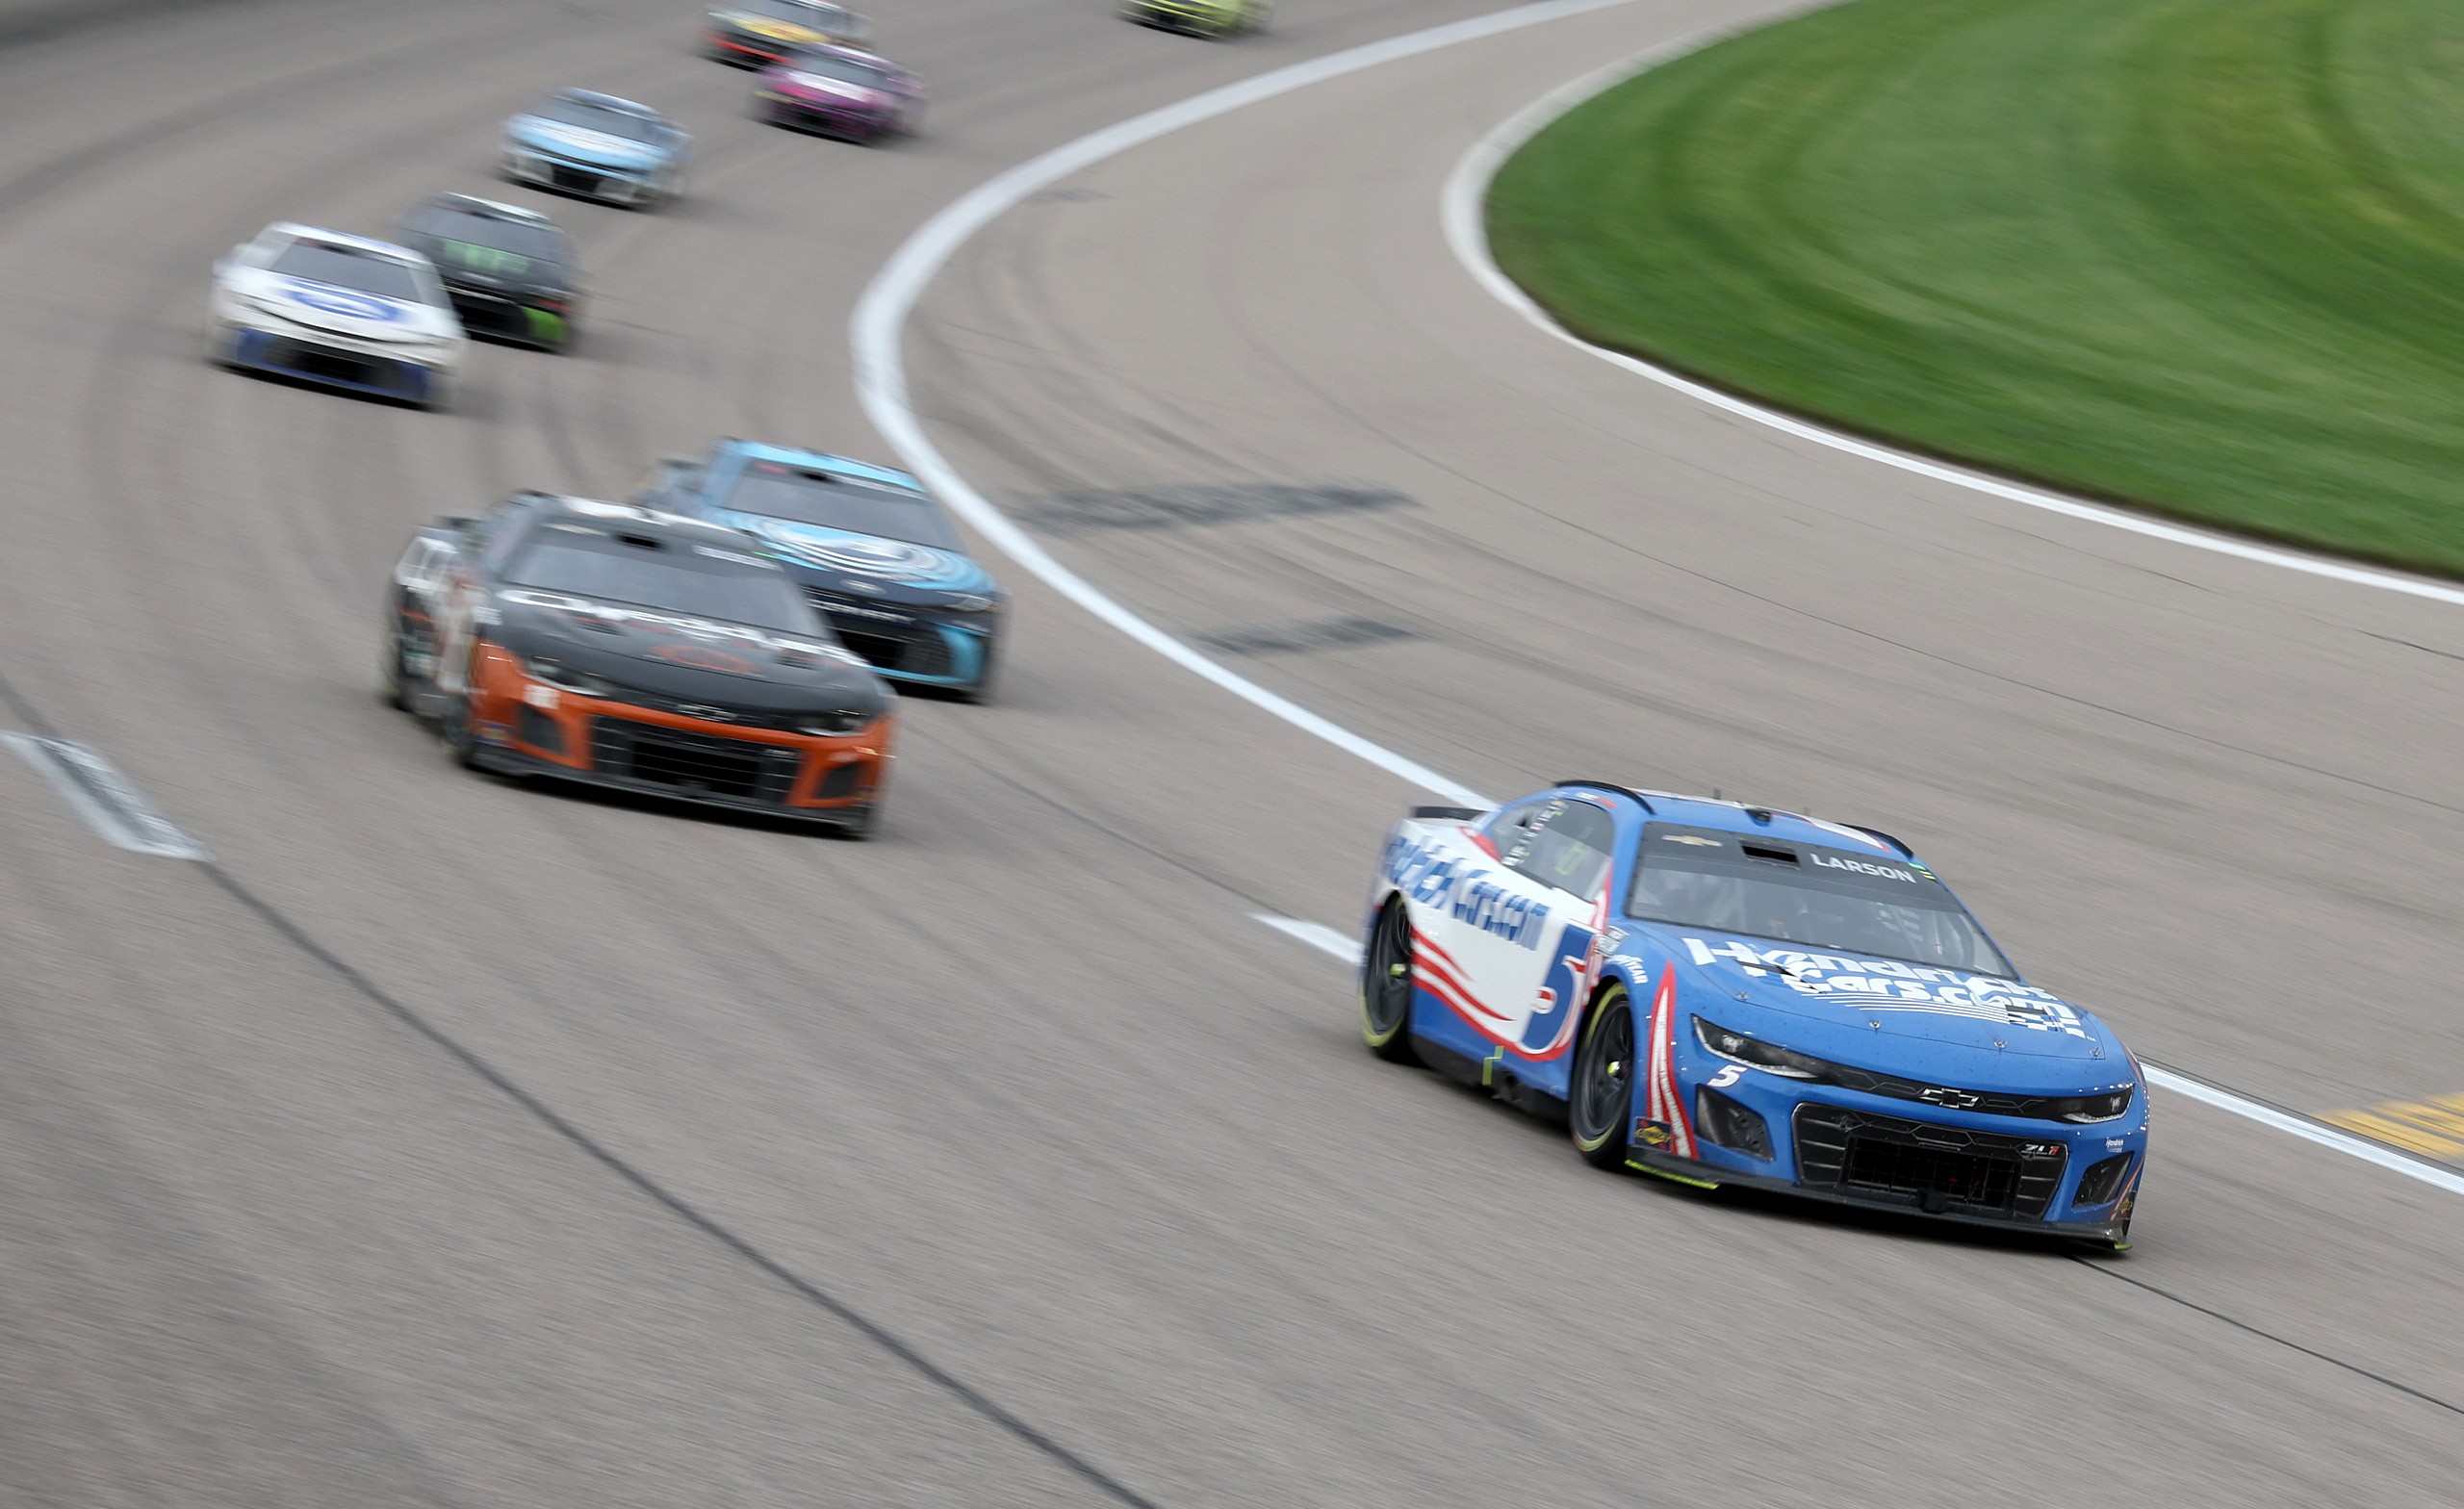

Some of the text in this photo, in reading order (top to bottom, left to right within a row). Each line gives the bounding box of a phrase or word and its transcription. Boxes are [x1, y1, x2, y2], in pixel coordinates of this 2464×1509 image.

[1810, 853, 1917, 883] LARSON
[1521, 922, 1598, 1052] 5
[1707, 1064, 1748, 1087] 5
[2020, 1143, 2061, 1156] ZL1
